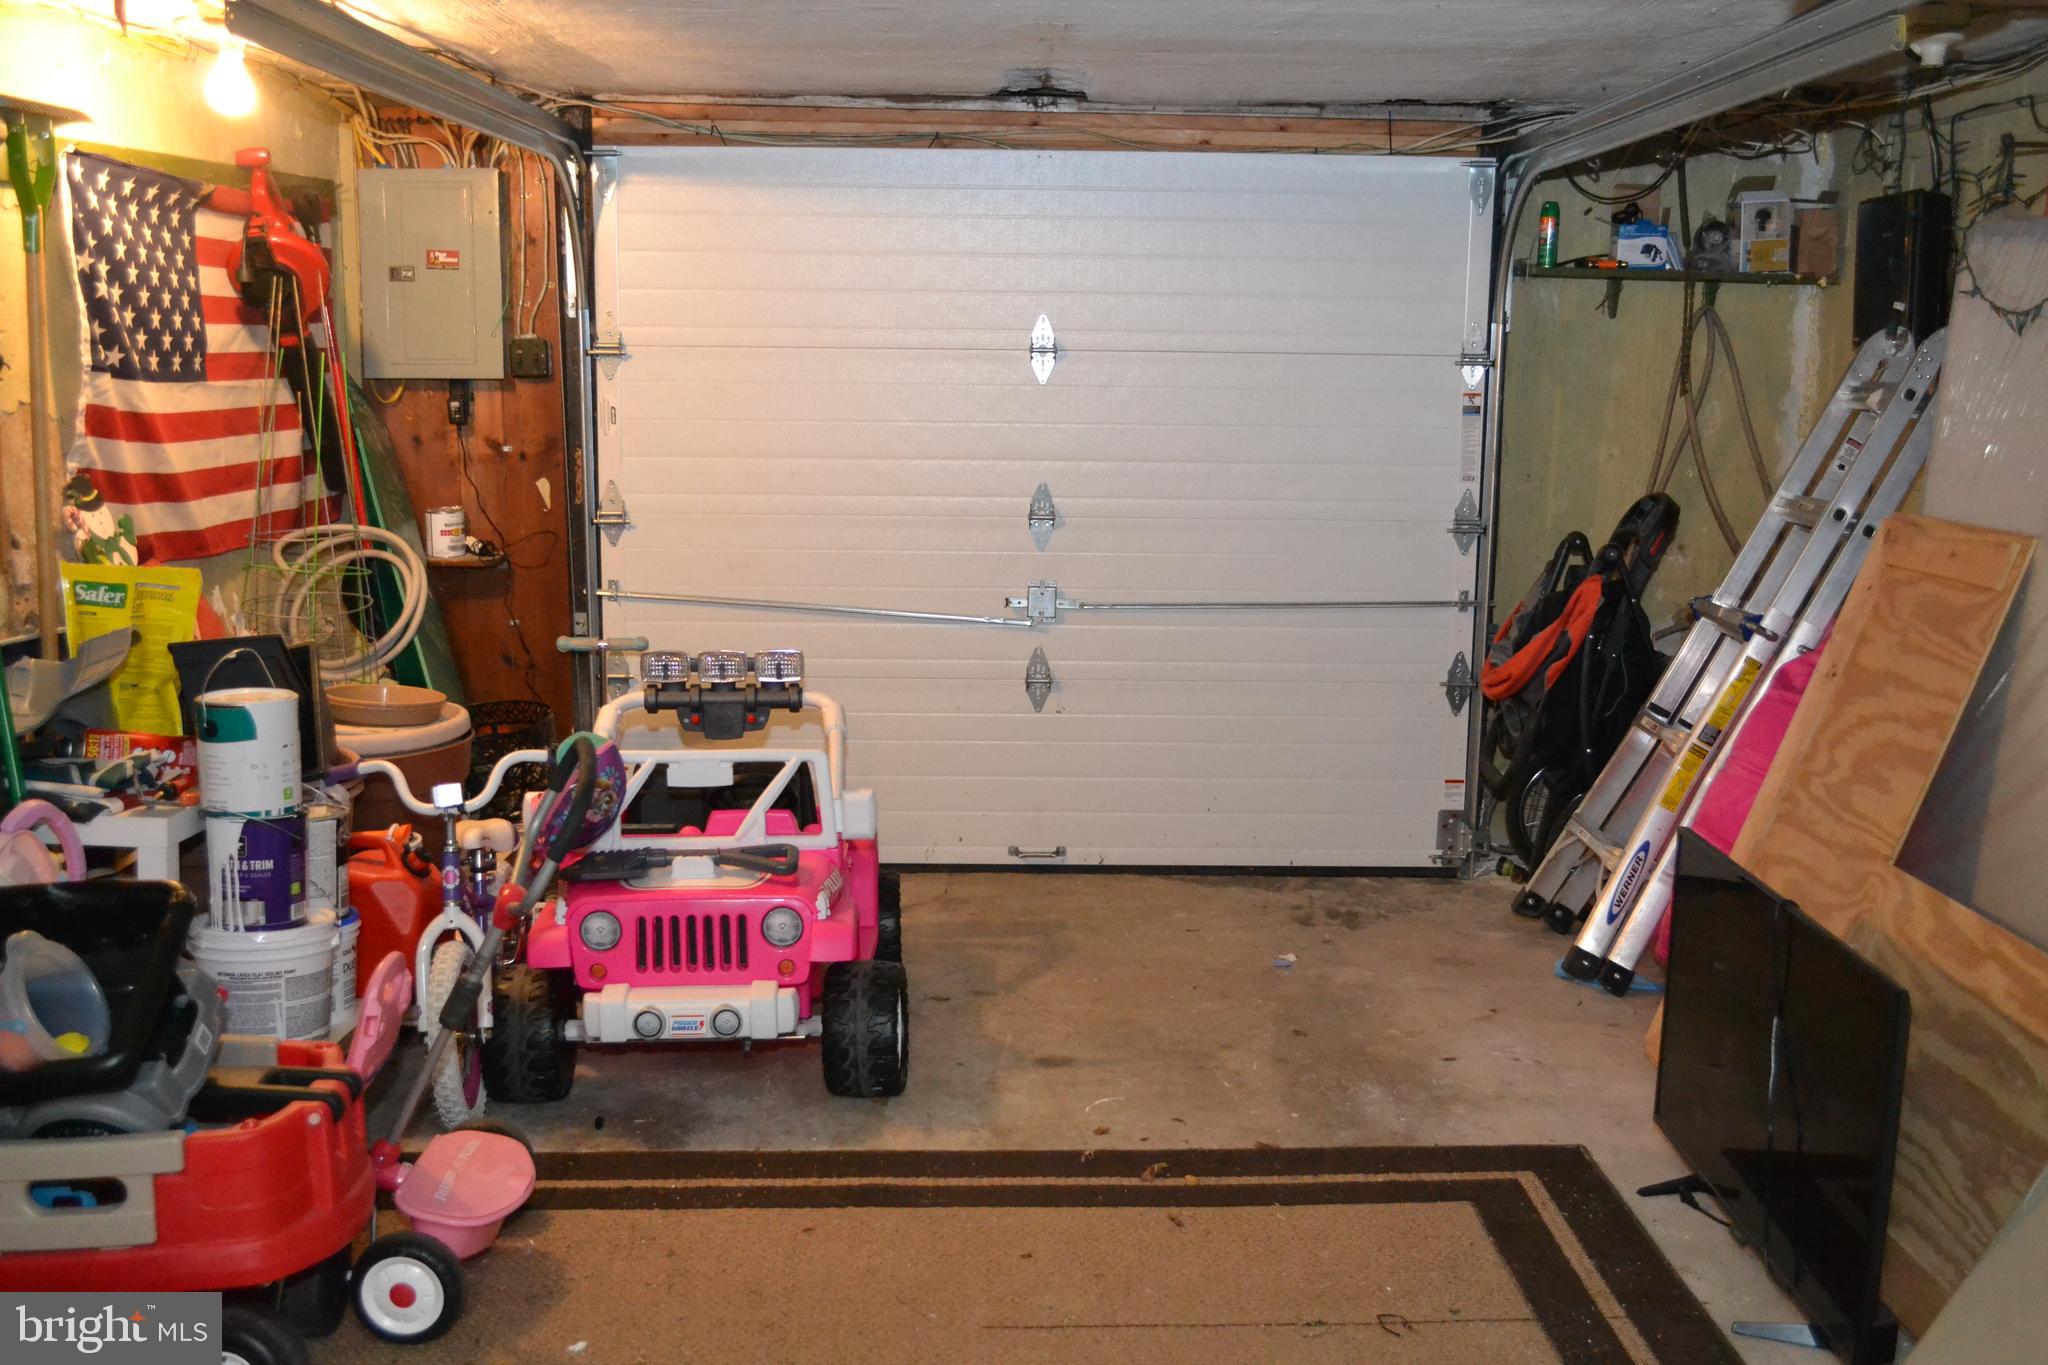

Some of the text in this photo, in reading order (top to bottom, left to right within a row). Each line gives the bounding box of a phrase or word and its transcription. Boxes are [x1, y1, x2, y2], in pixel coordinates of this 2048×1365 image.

[74, 583, 126, 604] Safer
[241, 860, 249, 871] &
[249, 859, 274, 870] TRIM
[1613, 855, 1644, 908] WERNER
